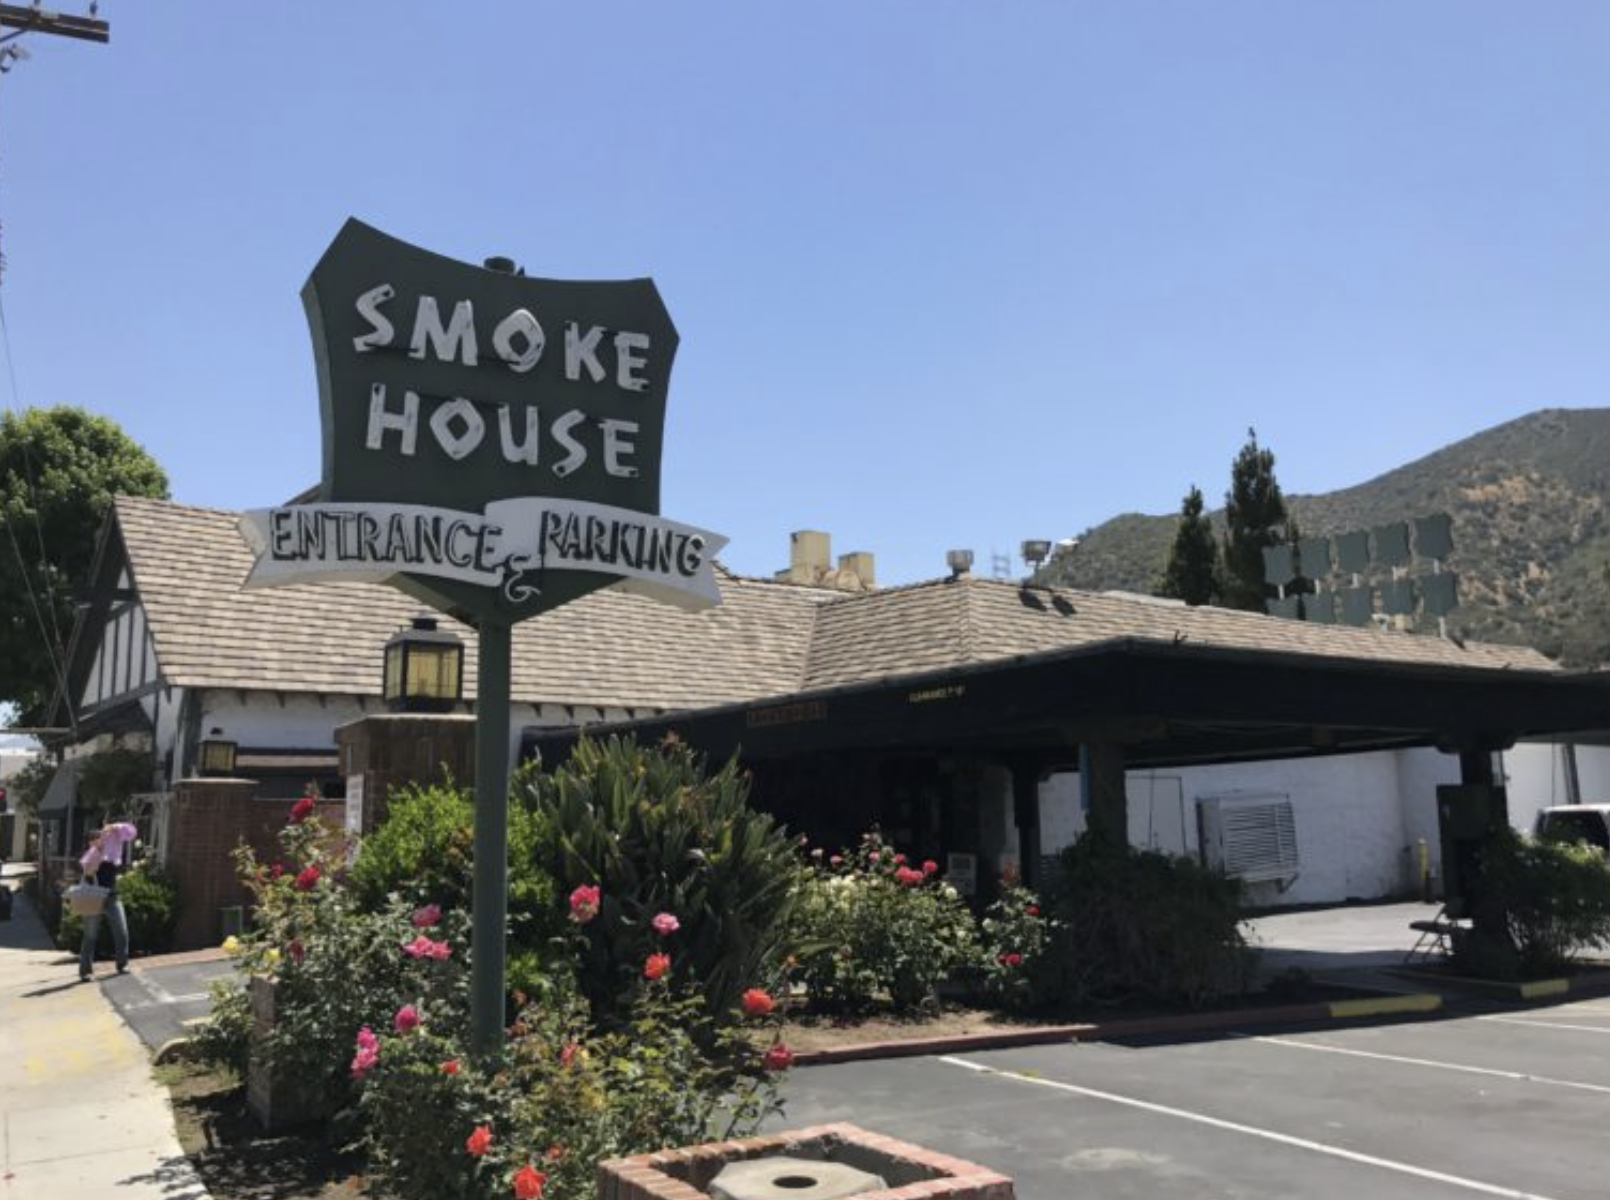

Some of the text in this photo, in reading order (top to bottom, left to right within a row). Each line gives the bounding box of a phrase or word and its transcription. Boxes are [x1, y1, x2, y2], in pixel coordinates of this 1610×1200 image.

[352, 283, 650, 392] SMOKE
[365, 382, 640, 478] HOUSE
[269, 509, 705, 602] ENTRANCE & PARKING
